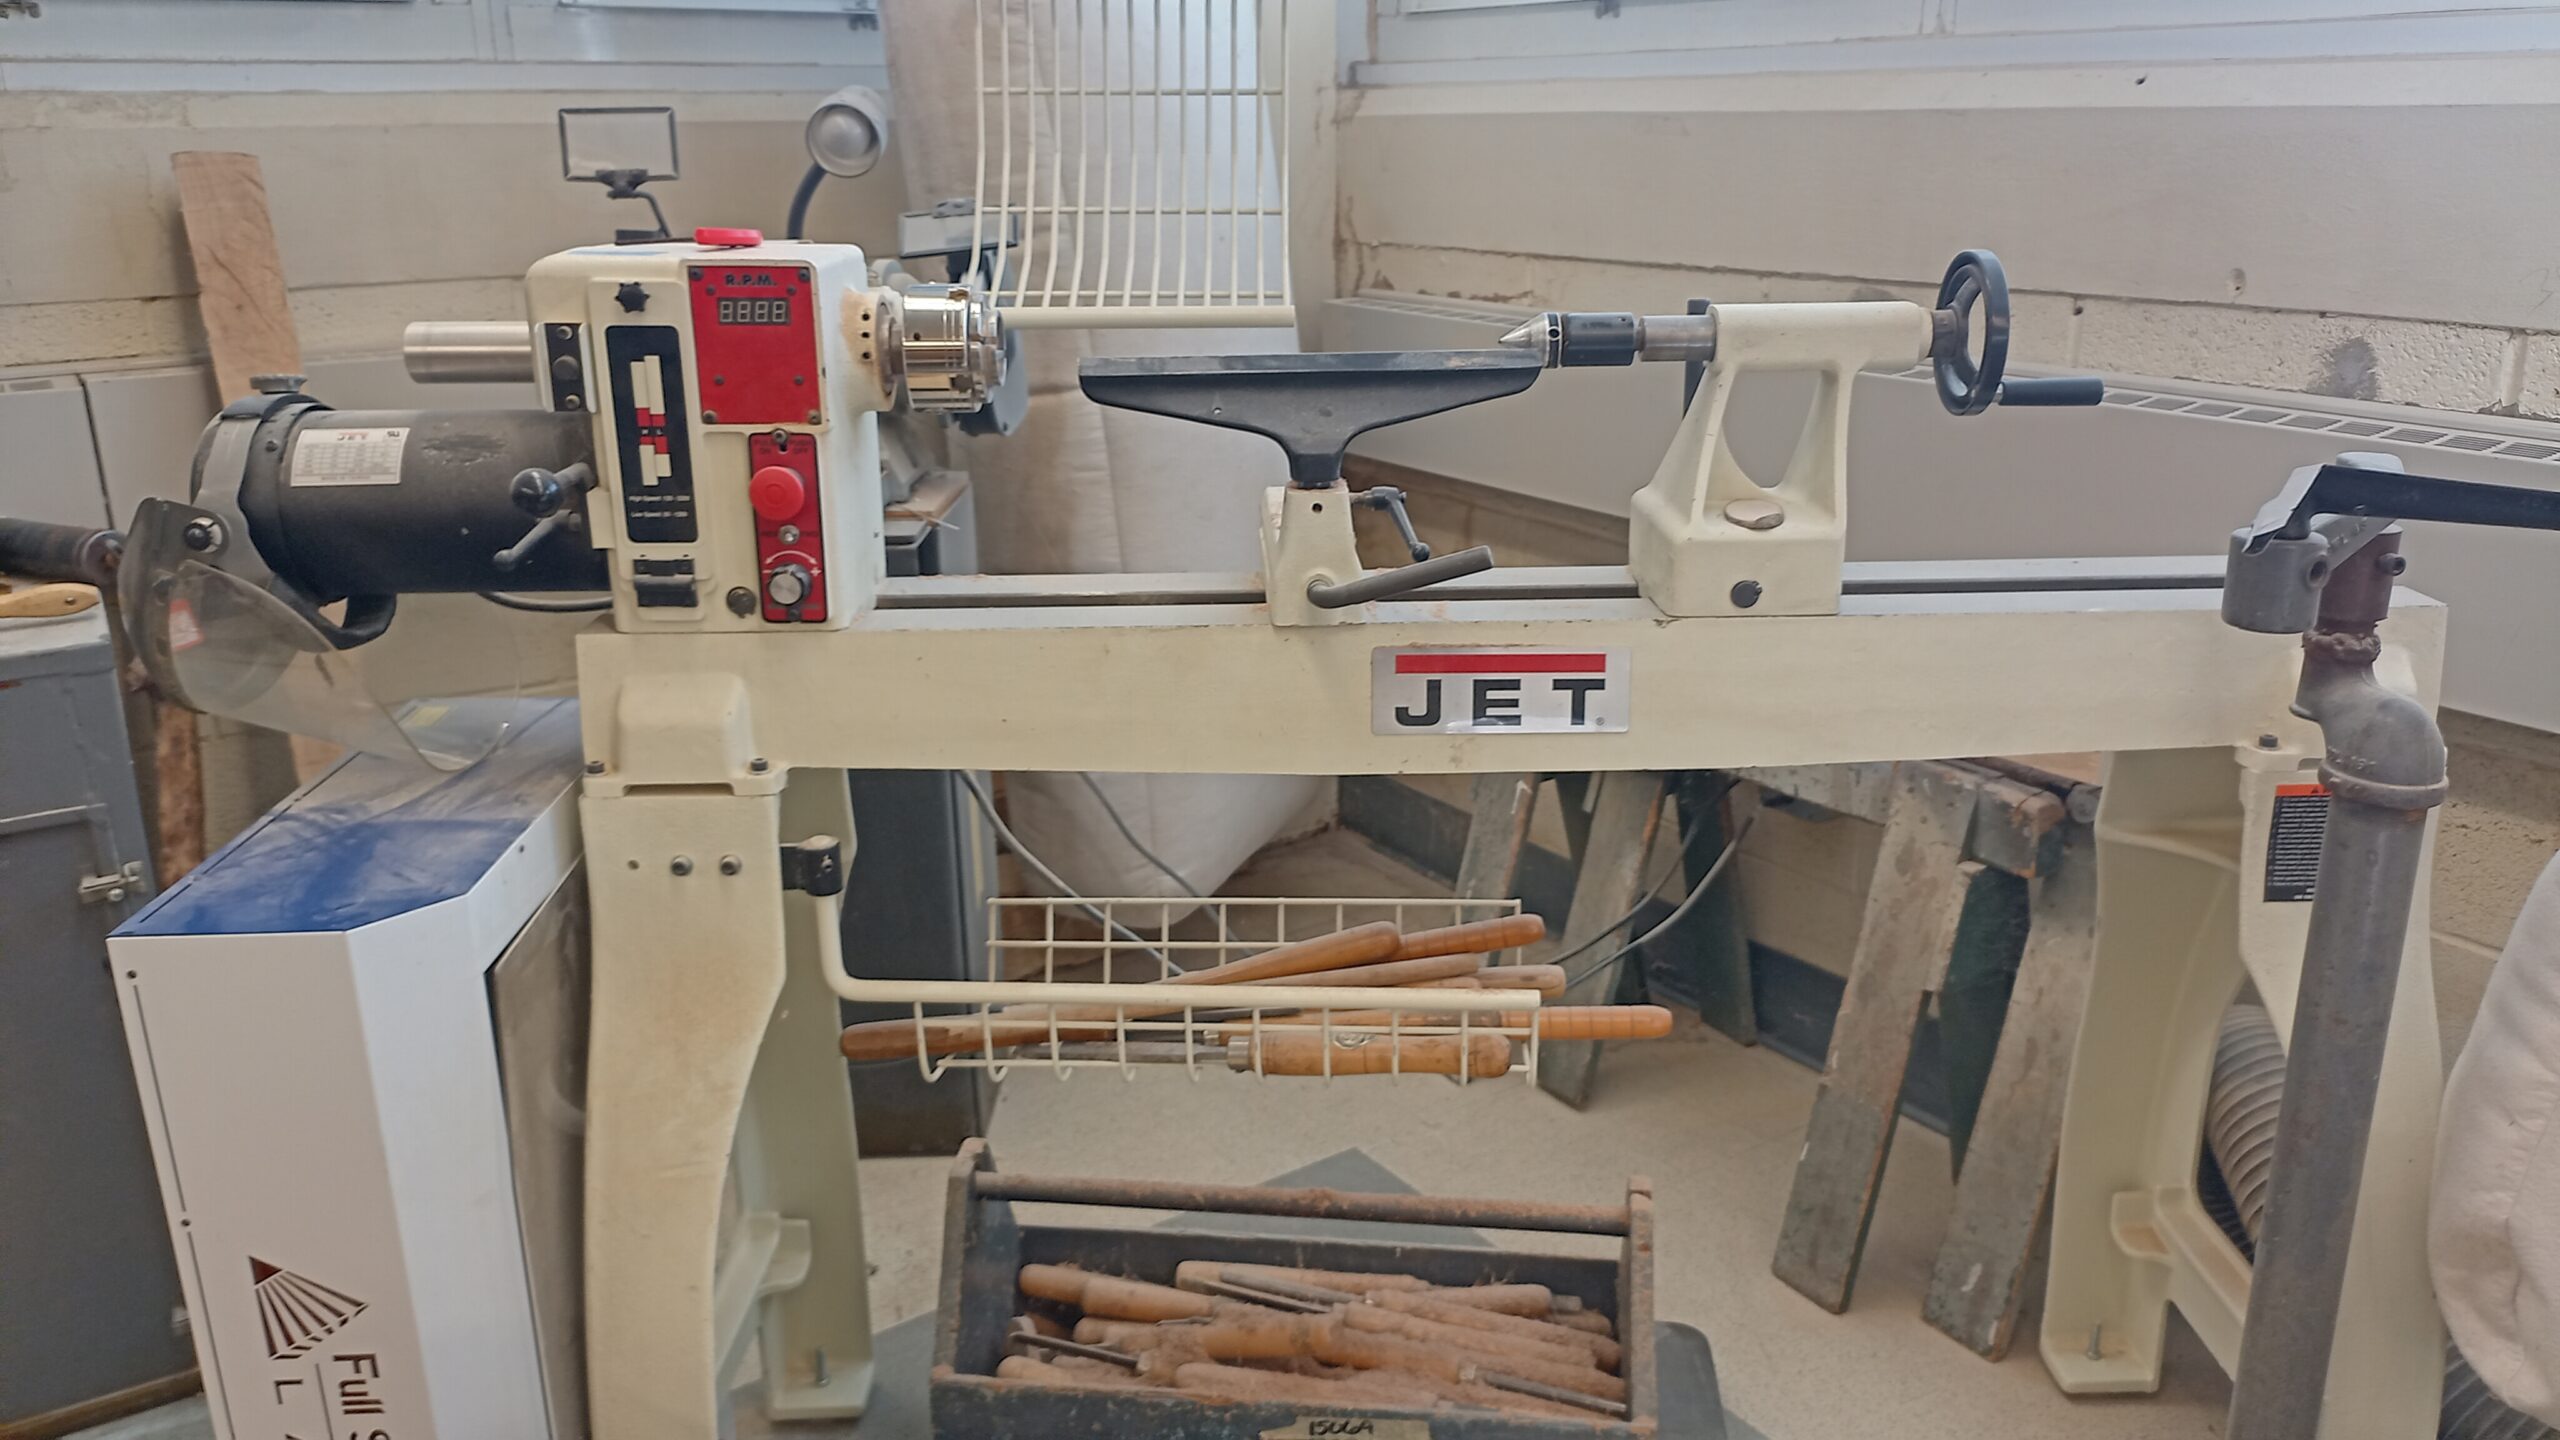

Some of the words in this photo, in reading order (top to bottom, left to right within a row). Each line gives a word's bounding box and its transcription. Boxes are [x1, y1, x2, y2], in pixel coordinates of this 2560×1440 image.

[725, 273, 778, 287] R.P.M.
[1395, 678, 1606, 726] JET
[333, 1353, 386, 1415] Full
